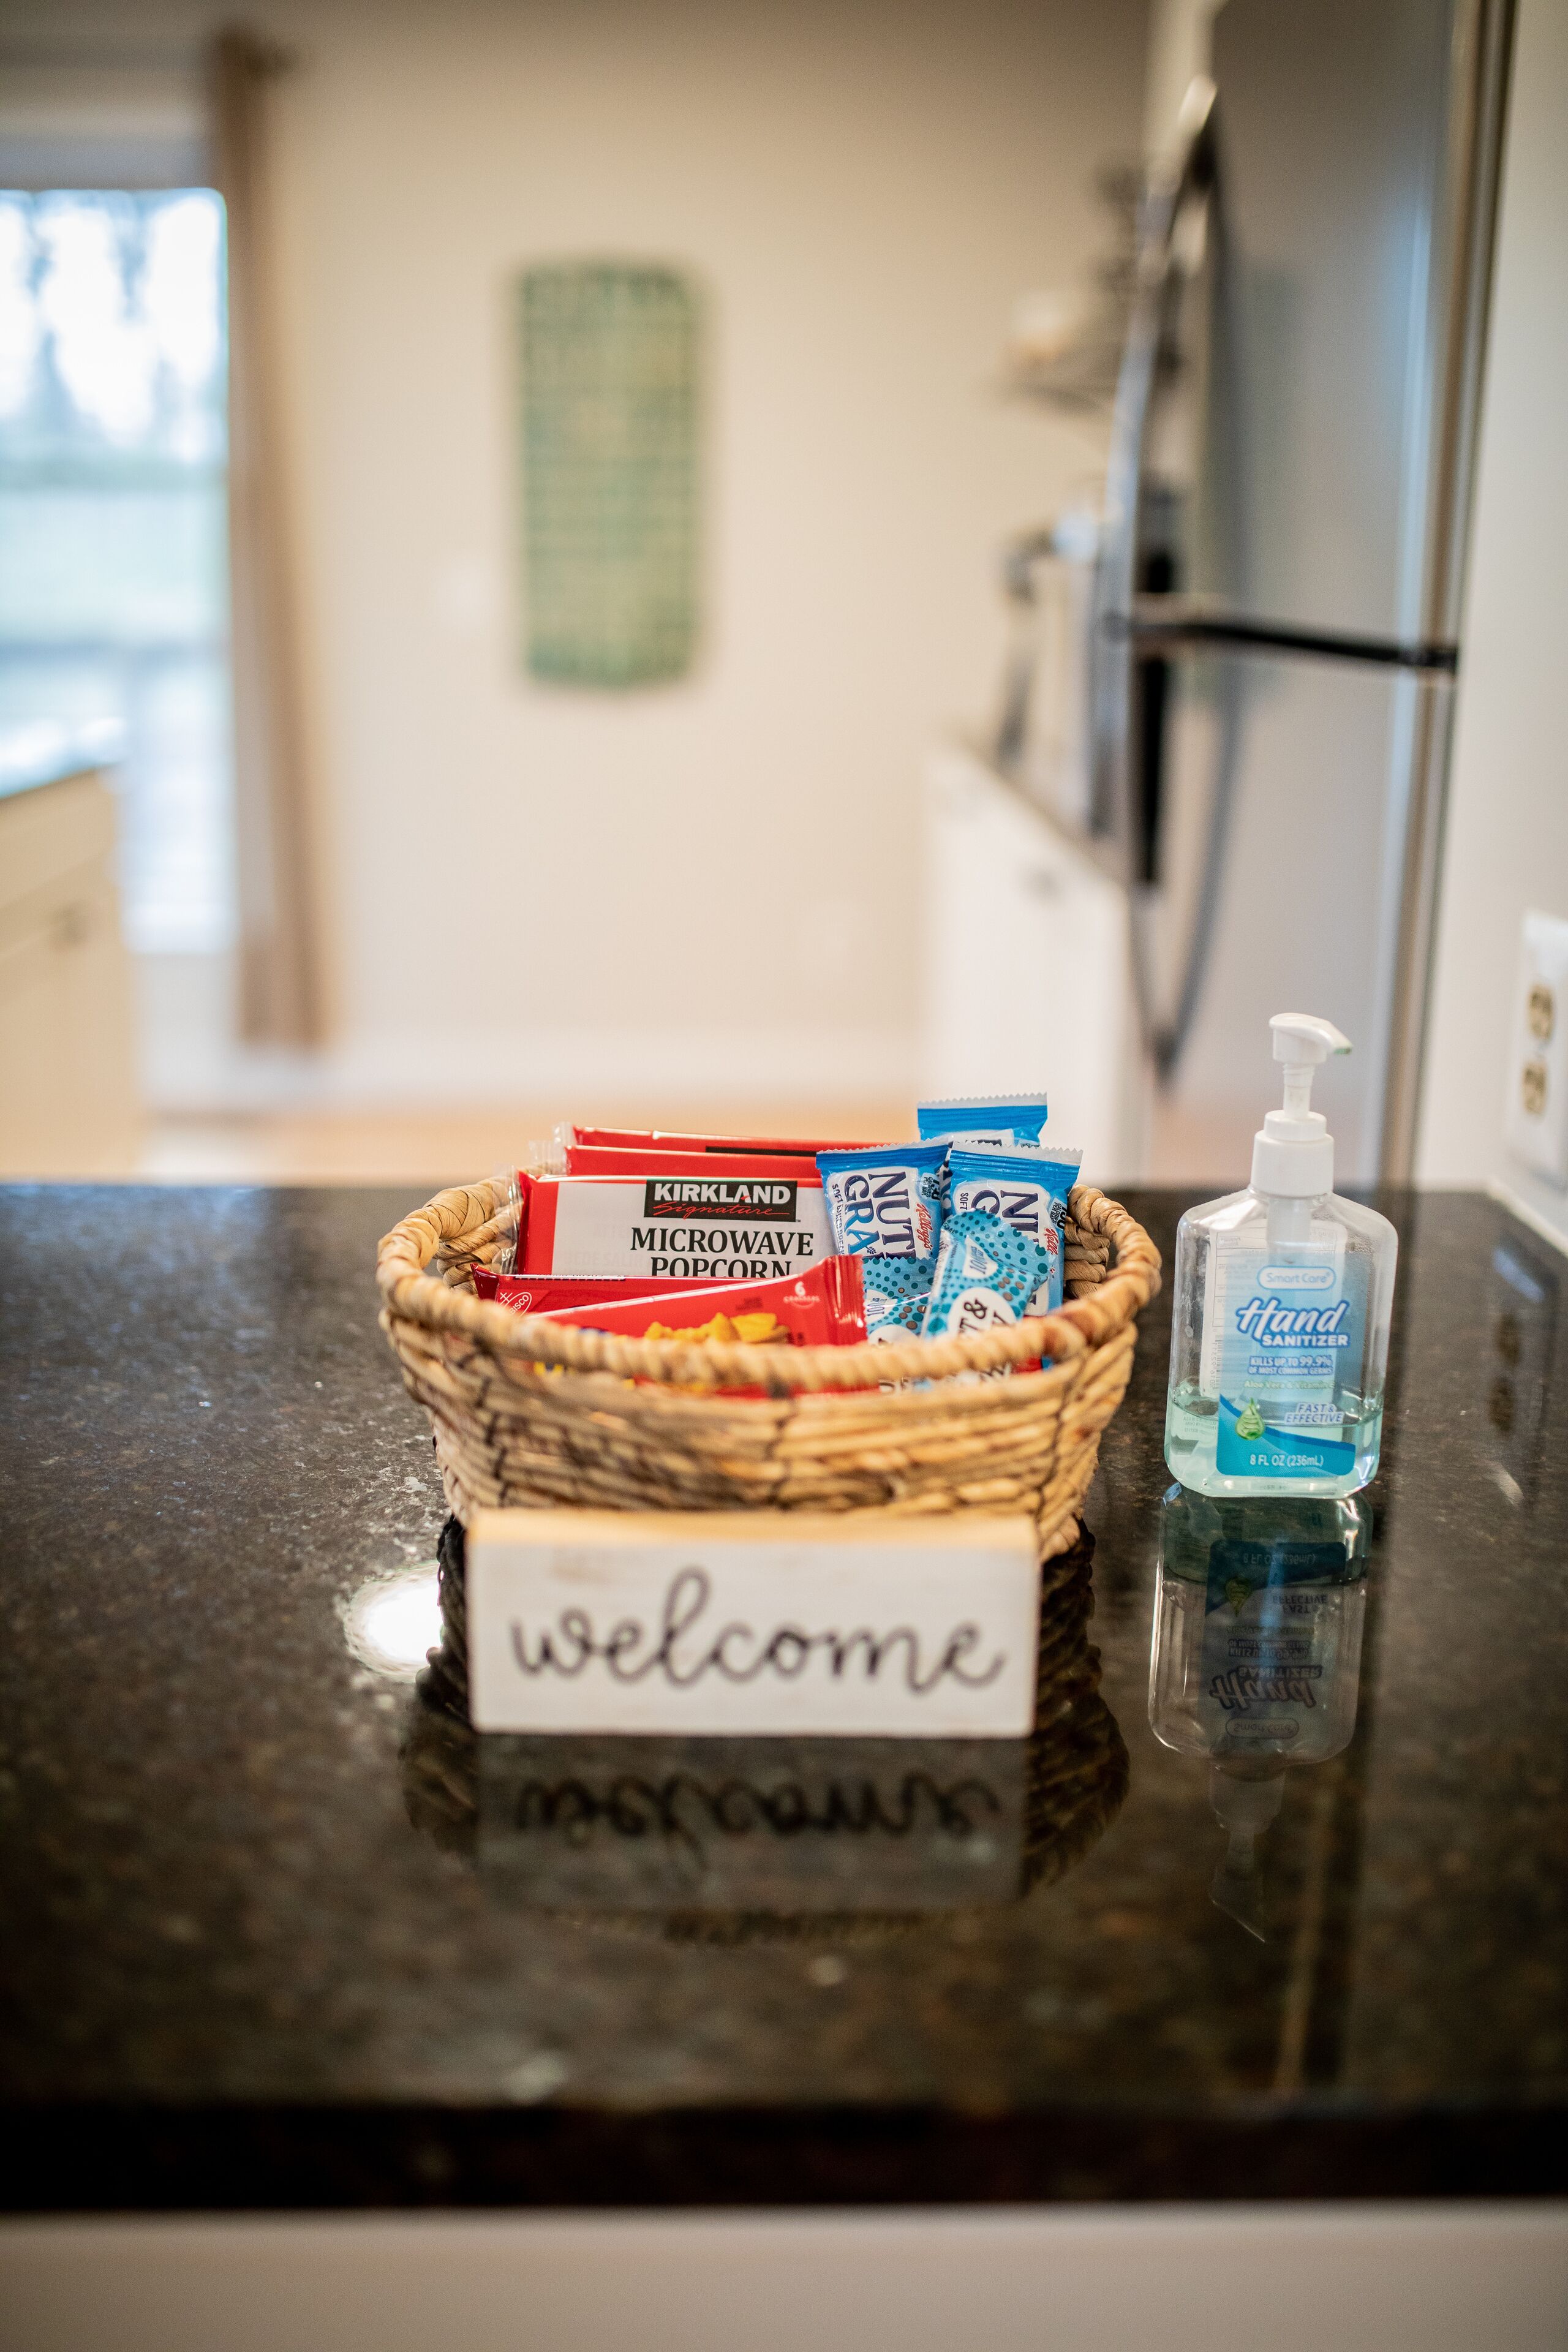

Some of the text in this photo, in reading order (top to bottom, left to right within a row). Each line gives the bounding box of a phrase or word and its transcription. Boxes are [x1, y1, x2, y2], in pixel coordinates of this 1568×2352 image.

[654, 1183, 791, 1204] KIRKLAND
[832, 1183, 843, 1204] SOFT
[960, 1193, 969, 1210] SOFT
[653, 1201, 790, 1219] Signature
[1053, 1203, 1061, 1224] CALORIES
[916, 1202, 933, 1250] Kellogg's
[630, 1227, 813, 1256] MICROWAVE
[650, 1257, 792, 1278] POPCORN
[1266, 1273, 1300, 1283] Smart
[794, 1281, 805, 1295] 6
[1237, 1298, 1349, 1338] Hand
[1262, 1335, 1349, 1347] SANITIZER
[1250, 1357, 1273, 1366] KILLS
[1275, 1357, 1287, 1366] UP
[1287, 1357, 1298, 1366] TO
[1297, 1403, 1328, 1412] FAST
[1286, 1413, 1344, 1423] EFFECTIVE
[1250, 1454, 1324, 1467] 8 FL OZ (236mL)
[508, 1562, 1006, 1695] welcome
